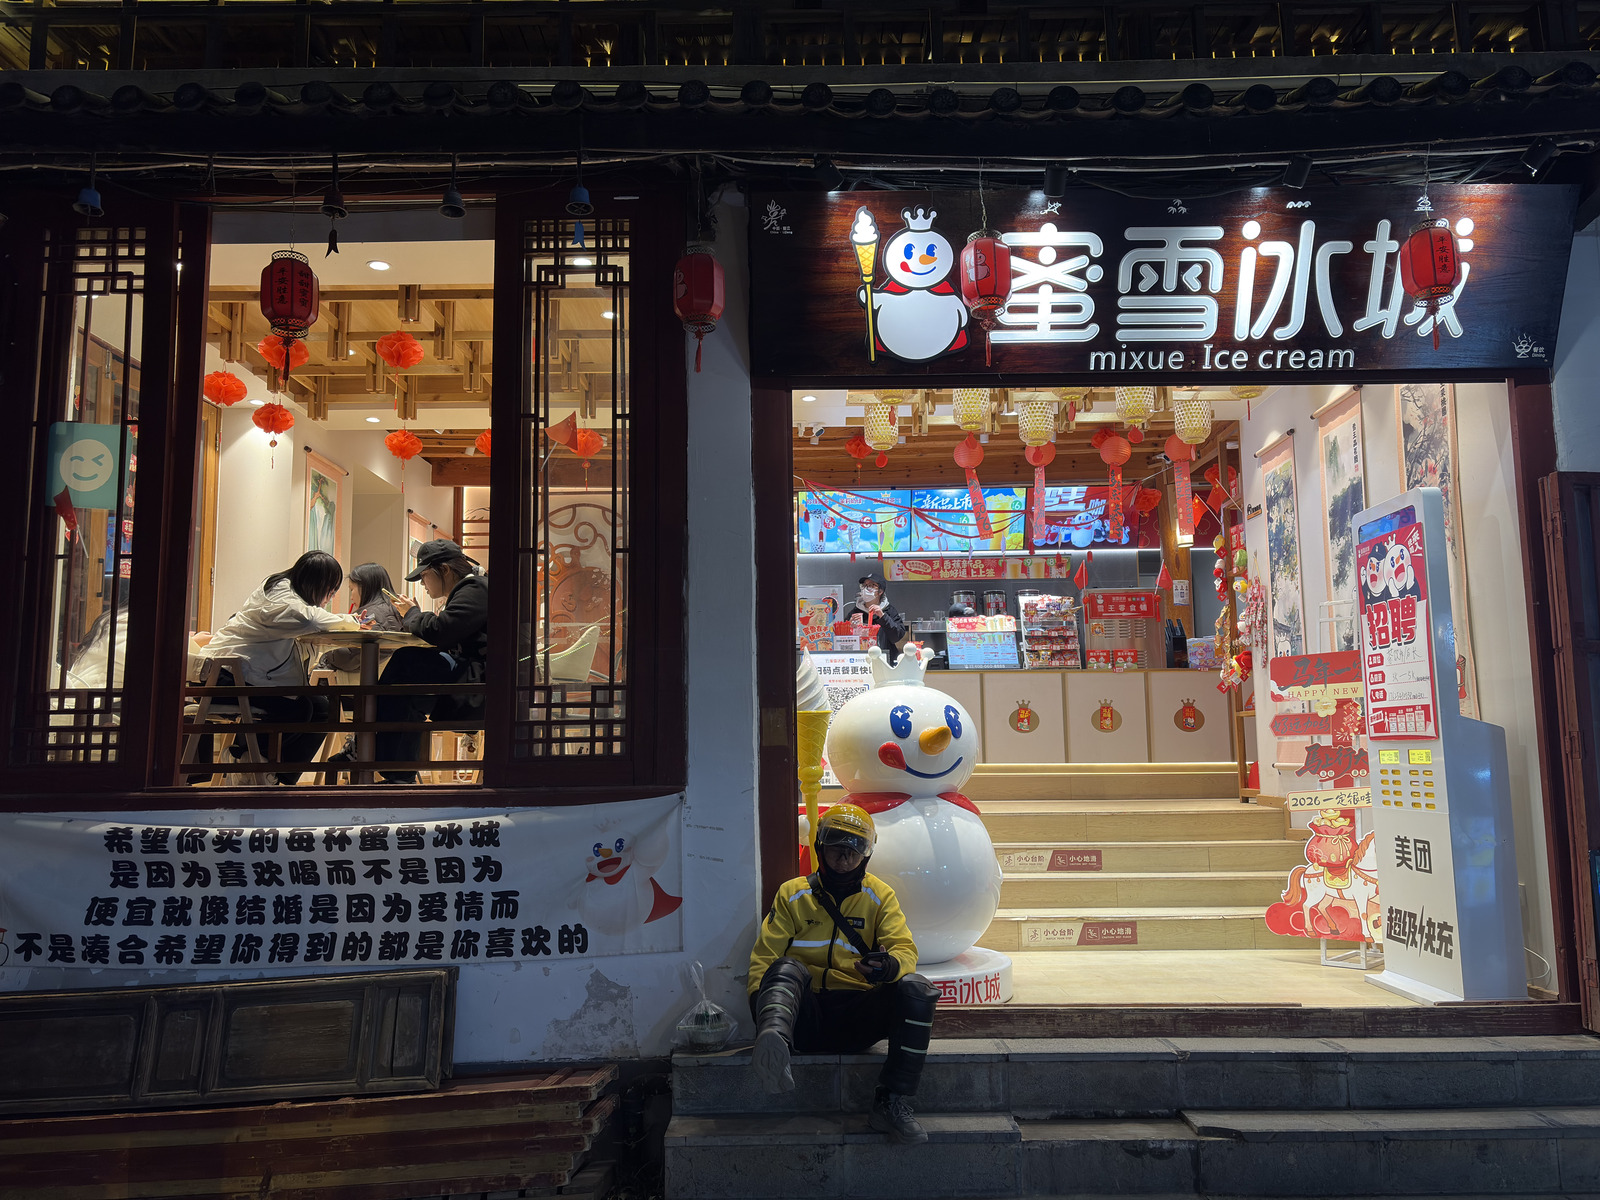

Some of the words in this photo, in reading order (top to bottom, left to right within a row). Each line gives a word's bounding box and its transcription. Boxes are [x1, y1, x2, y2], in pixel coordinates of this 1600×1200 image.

[1436, 236, 1450, 273] 平安胜意
[275, 267, 288, 304] 平安胜意
[988, 217, 1475, 343] 蜜雪冰城
[1089, 345, 1184, 370] mixue
[1204, 344, 1257, 370] Ice
[1263, 350, 1355, 370] cream
[921, 493, 972, 510] 新品上市
[972, 497, 991, 531] 2026
[1366, 594, 1418, 649] 招聘
[1288, 689, 1326, 698] HAPPY
[1333, 687, 1359, 696] NEW
[1376, 690, 1384, 699] 电话
[1273, 717, 1330, 734] 好运加马
[104, 821, 502, 854] 希望你买的每杯蜜雪冰城
[1395, 835, 1432, 875] 美团
[109, 856, 502, 889] 是因为喜欢喝而不是因为
[84, 889, 519, 928] 便宜就像结婚是因为爱情而
[14, 924, 588, 966] 不是凑合希望你得到的都是你喜欢的
[1043, 928, 1074, 936] 小心台阶
[1386, 905, 1454, 960] 超级快充
[932, 972, 1001, 1004] 雪冰城
